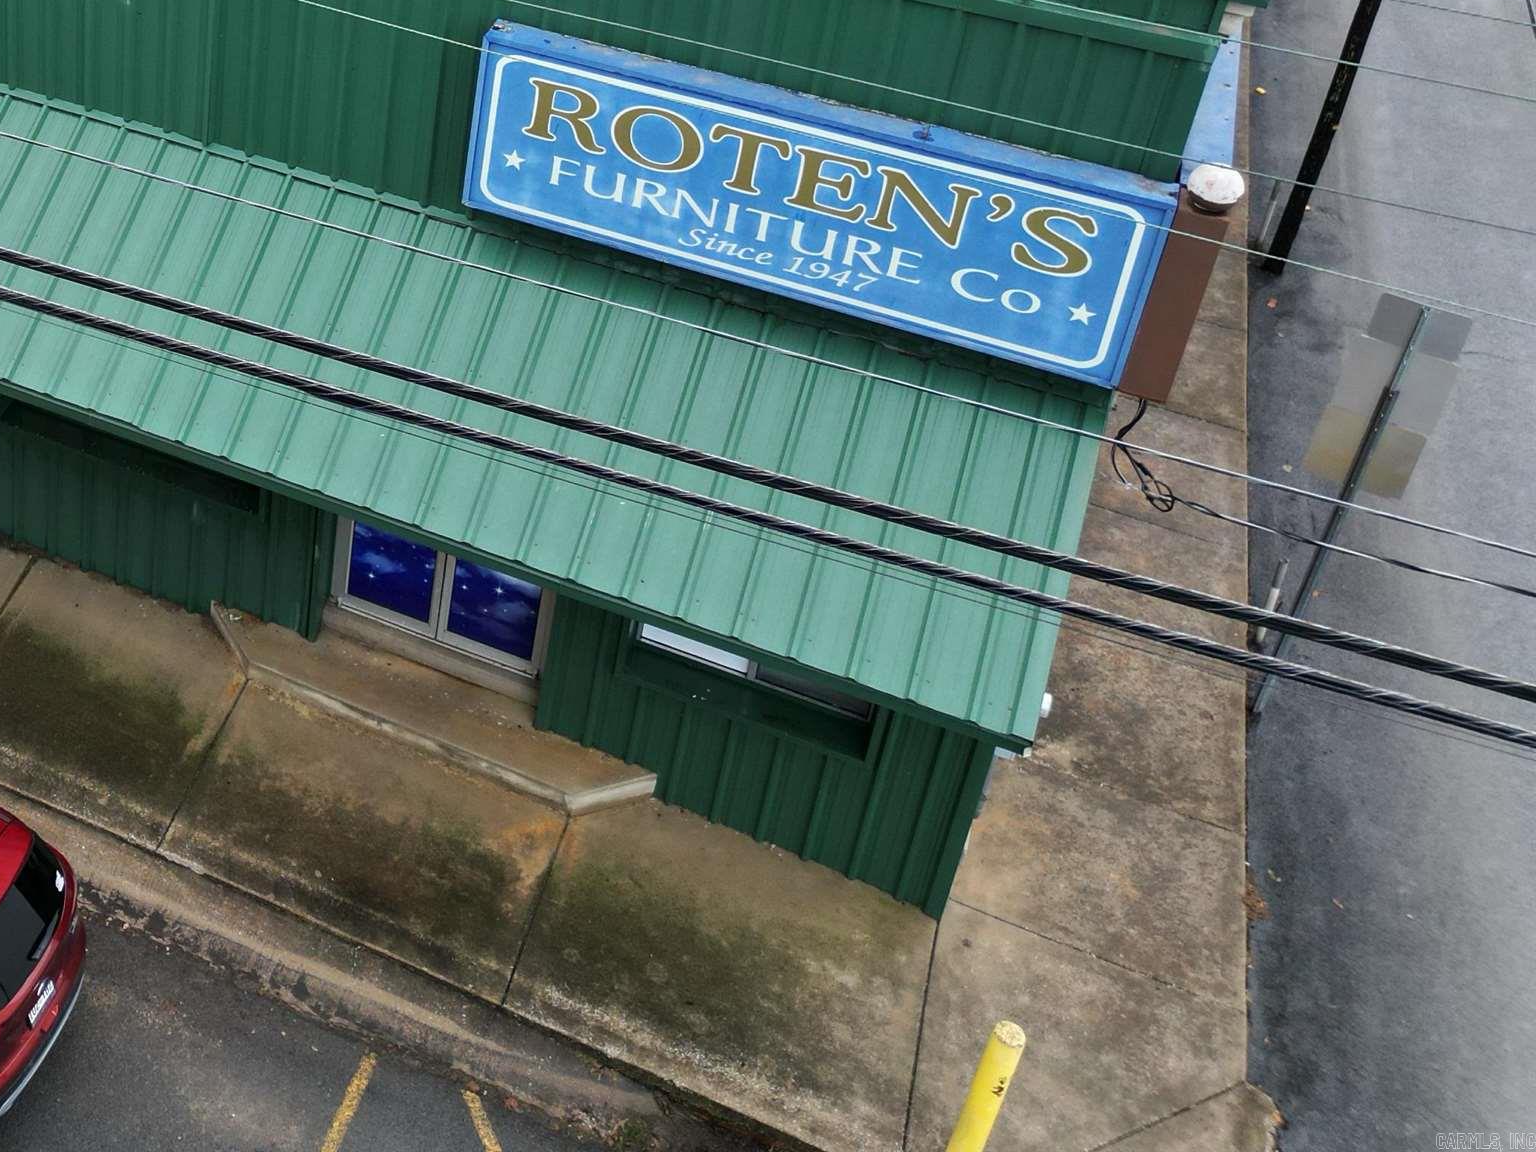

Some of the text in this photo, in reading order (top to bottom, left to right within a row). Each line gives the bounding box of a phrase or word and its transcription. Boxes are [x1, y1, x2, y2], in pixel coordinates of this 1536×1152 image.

[521, 76, 1099, 279] ROTEN'S
[549, 154, 922, 285] FURNITURE
[677, 227, 880, 292] Since 1947
